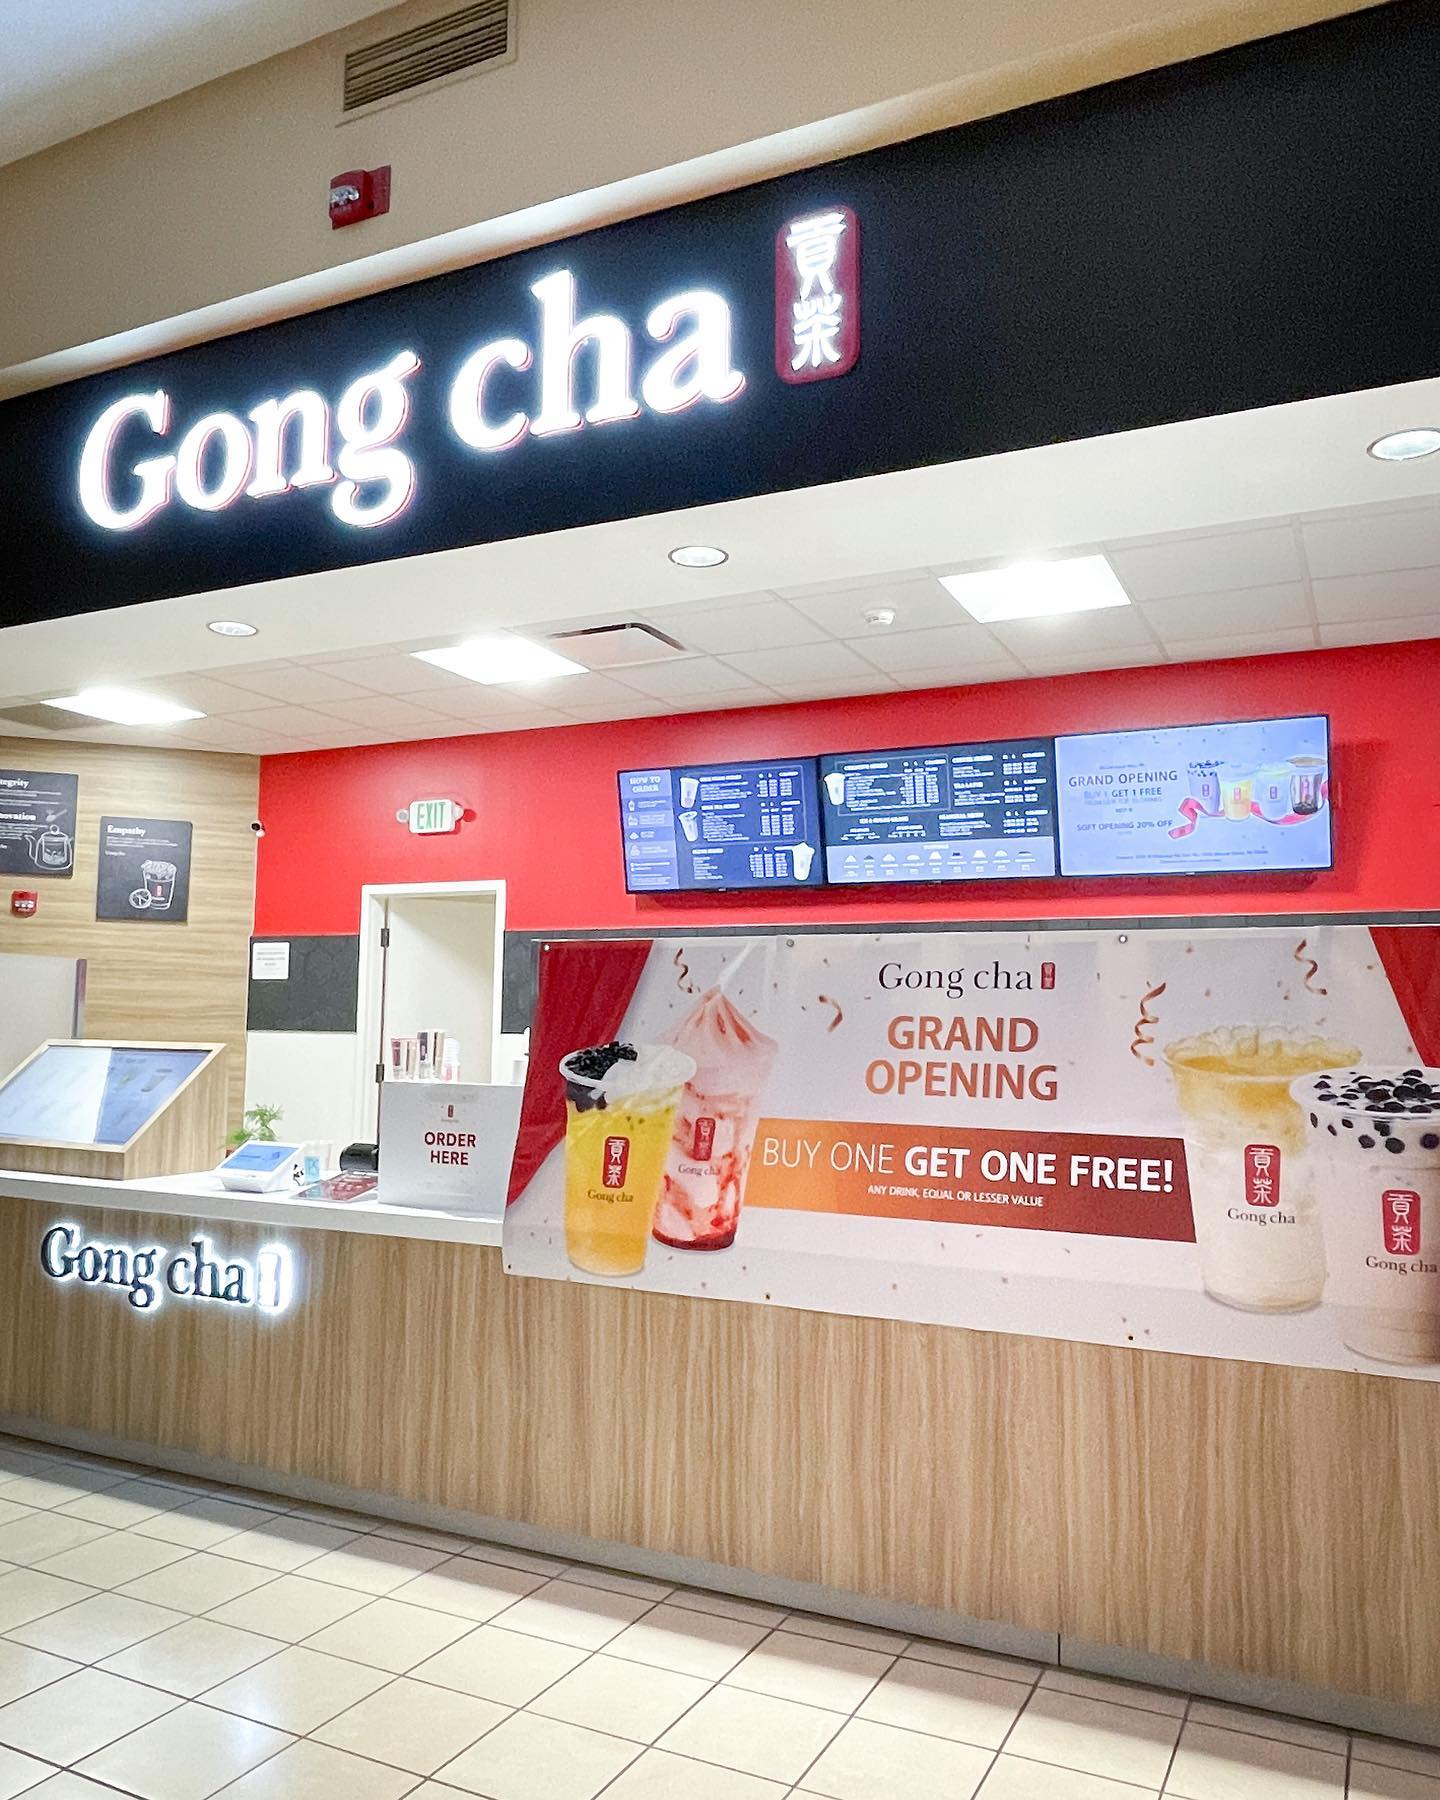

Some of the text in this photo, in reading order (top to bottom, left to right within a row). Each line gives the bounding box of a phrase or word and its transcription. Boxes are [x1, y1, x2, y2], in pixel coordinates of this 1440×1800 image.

[786, 212, 847, 371] 貢茶
[79, 268, 746, 530] Gong cha
[1069, 770, 1178, 787] GRAND OPENING
[1111, 789, 1129, 798] GET
[1139, 786, 1162, 797] FREE
[417, 802, 446, 830] EXIT
[1076, 819, 1173, 832] SOFT OPENING 20% OFF
[107, 824, 146, 837] Empathy
[878, 962, 965, 1000] Gong
[973, 960, 1033, 990] cha
[887, 1015, 1039, 1053] GRAND
[865, 1059, 1058, 1101] OPENING
[424, 1131, 477, 1148] ORDER
[430, 1149, 469, 1166] HERE
[604, 1139, 626, 1186] 貢茶
[678, 1162, 703, 1177] Gong
[763, 1137, 1174, 1194] BUY ONE GET ONE FREE!
[1249, 1147, 1274, 1204] 貢茶
[587, 1188, 634, 1204] Gong cha
[867, 1184, 889, 1196] ANY
[922, 1188, 955, 1201] EQUAL
[956, 1190, 972, 1202] OR
[973, 1191, 1010, 1205] LESSER
[1011, 1195, 1044, 1208] VALUE
[1227, 1207, 1296, 1226] Gong cha
[1386, 1192, 1414, 1253] 貢茶
[41, 1225, 251, 1308] Gong cha
[1366, 1255, 1438, 1275] Gong cha
